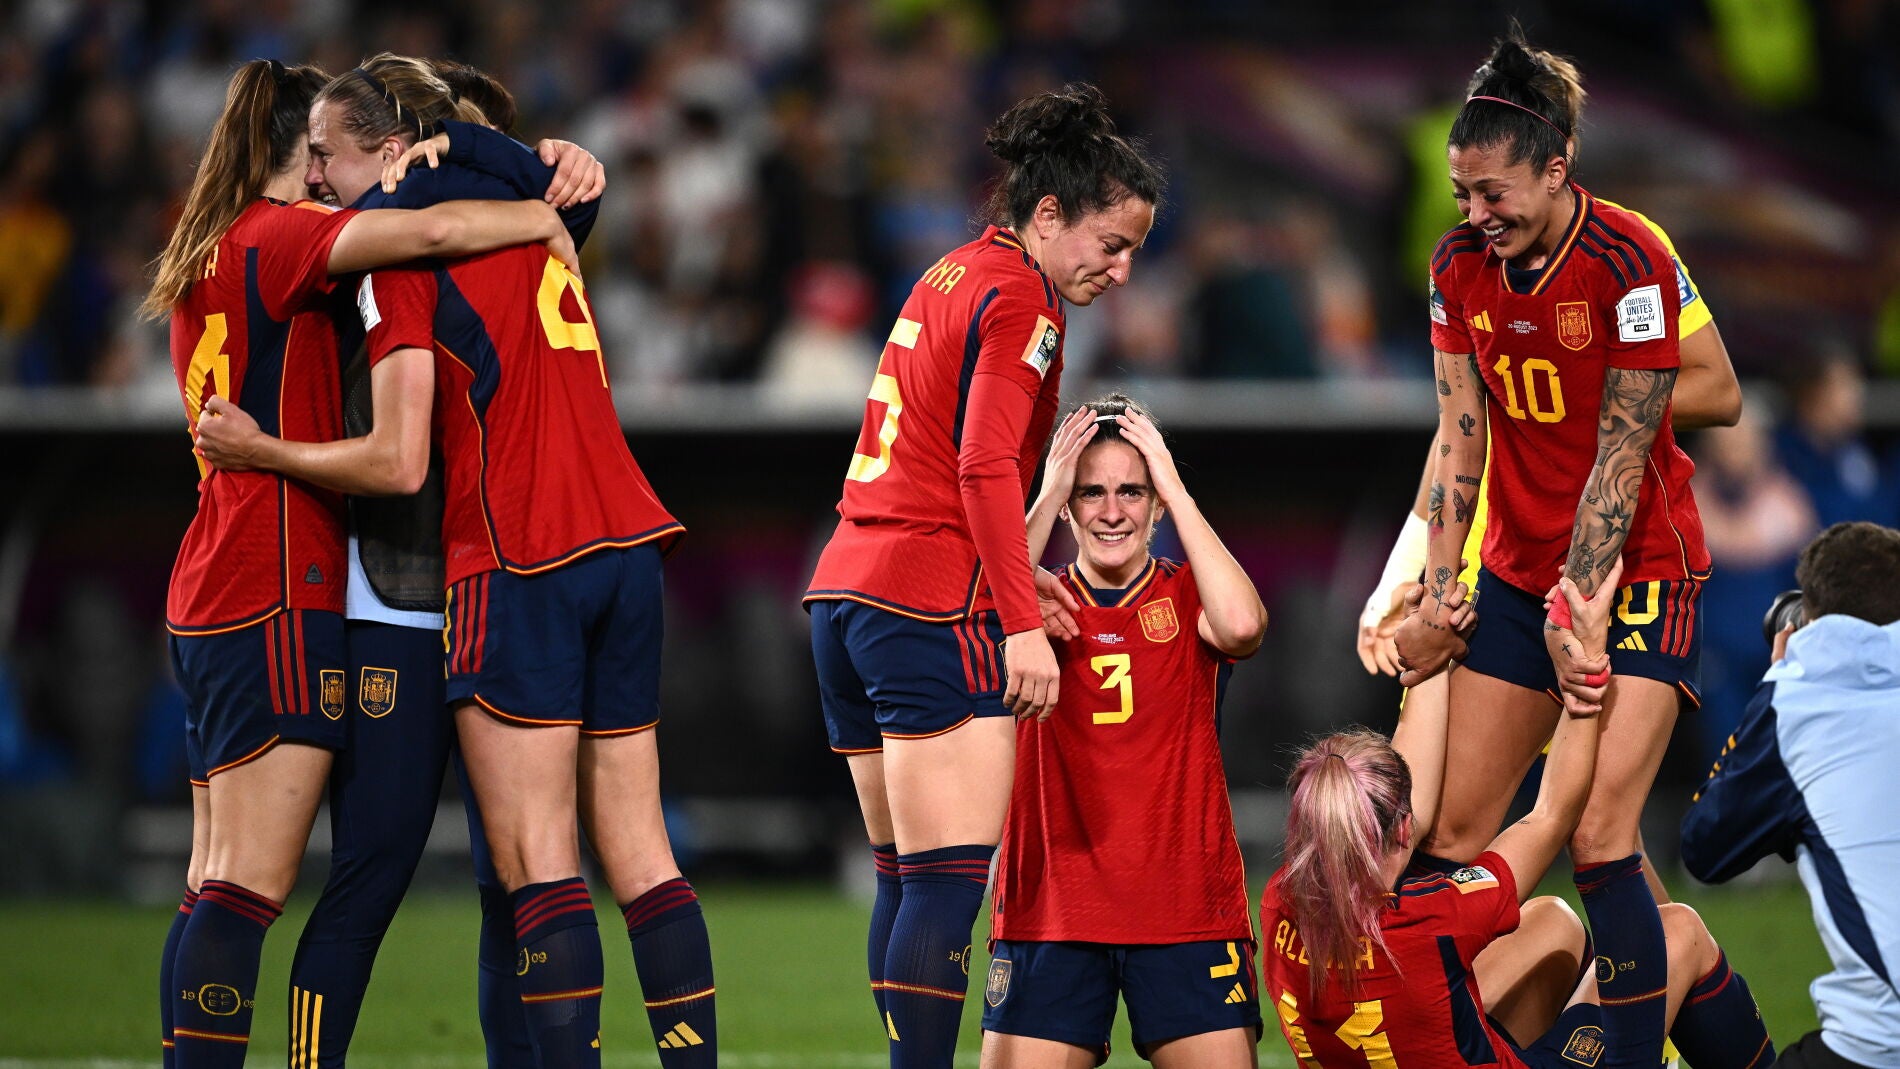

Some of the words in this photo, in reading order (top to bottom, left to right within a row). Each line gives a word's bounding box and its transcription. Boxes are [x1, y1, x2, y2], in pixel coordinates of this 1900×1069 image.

[1625, 296, 1652, 306] FOOTBALL
[1627, 303, 1653, 315] UNITES
[537, 254, 608, 389] 4
[1637, 313, 1655, 323] World
[1492, 354, 1566, 423] 10
[845, 317, 923, 483] 5
[1090, 653, 1134, 725] 3
[531, 951, 548, 964] 09
[948, 950, 961, 962] 19
[181, 989, 196, 1001] 19
